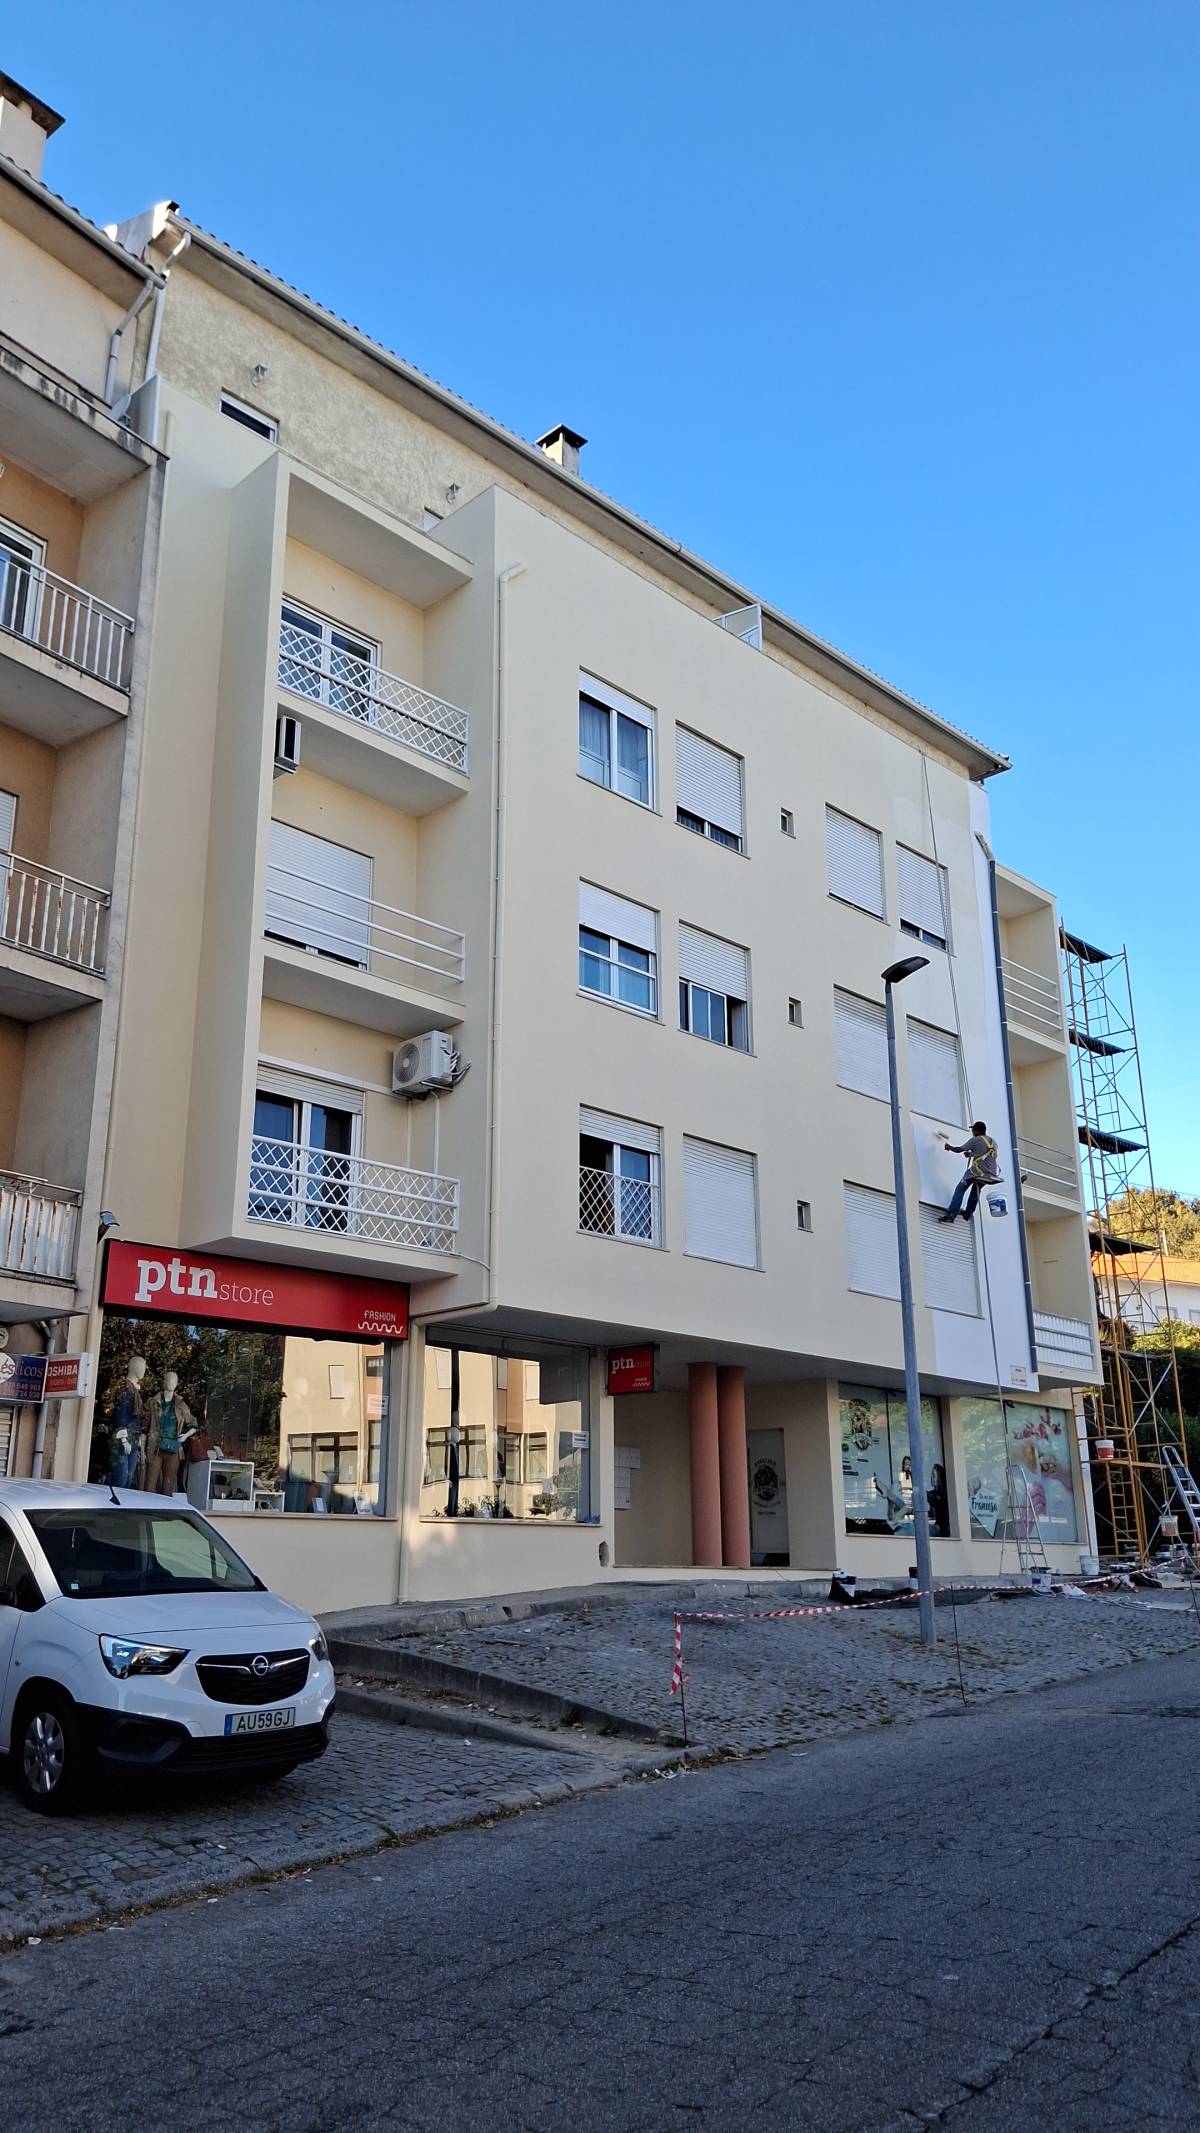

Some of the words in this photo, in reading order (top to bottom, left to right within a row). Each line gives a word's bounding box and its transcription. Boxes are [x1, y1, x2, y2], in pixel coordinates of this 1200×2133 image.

[134, 1257, 218, 1303] ptn
[219, 1281, 274, 1306] store
[364, 1310, 397, 1322] FASHION
[611, 1356, 635, 1375] ptn
[236, 1710, 290, 1731] AU59GJ
